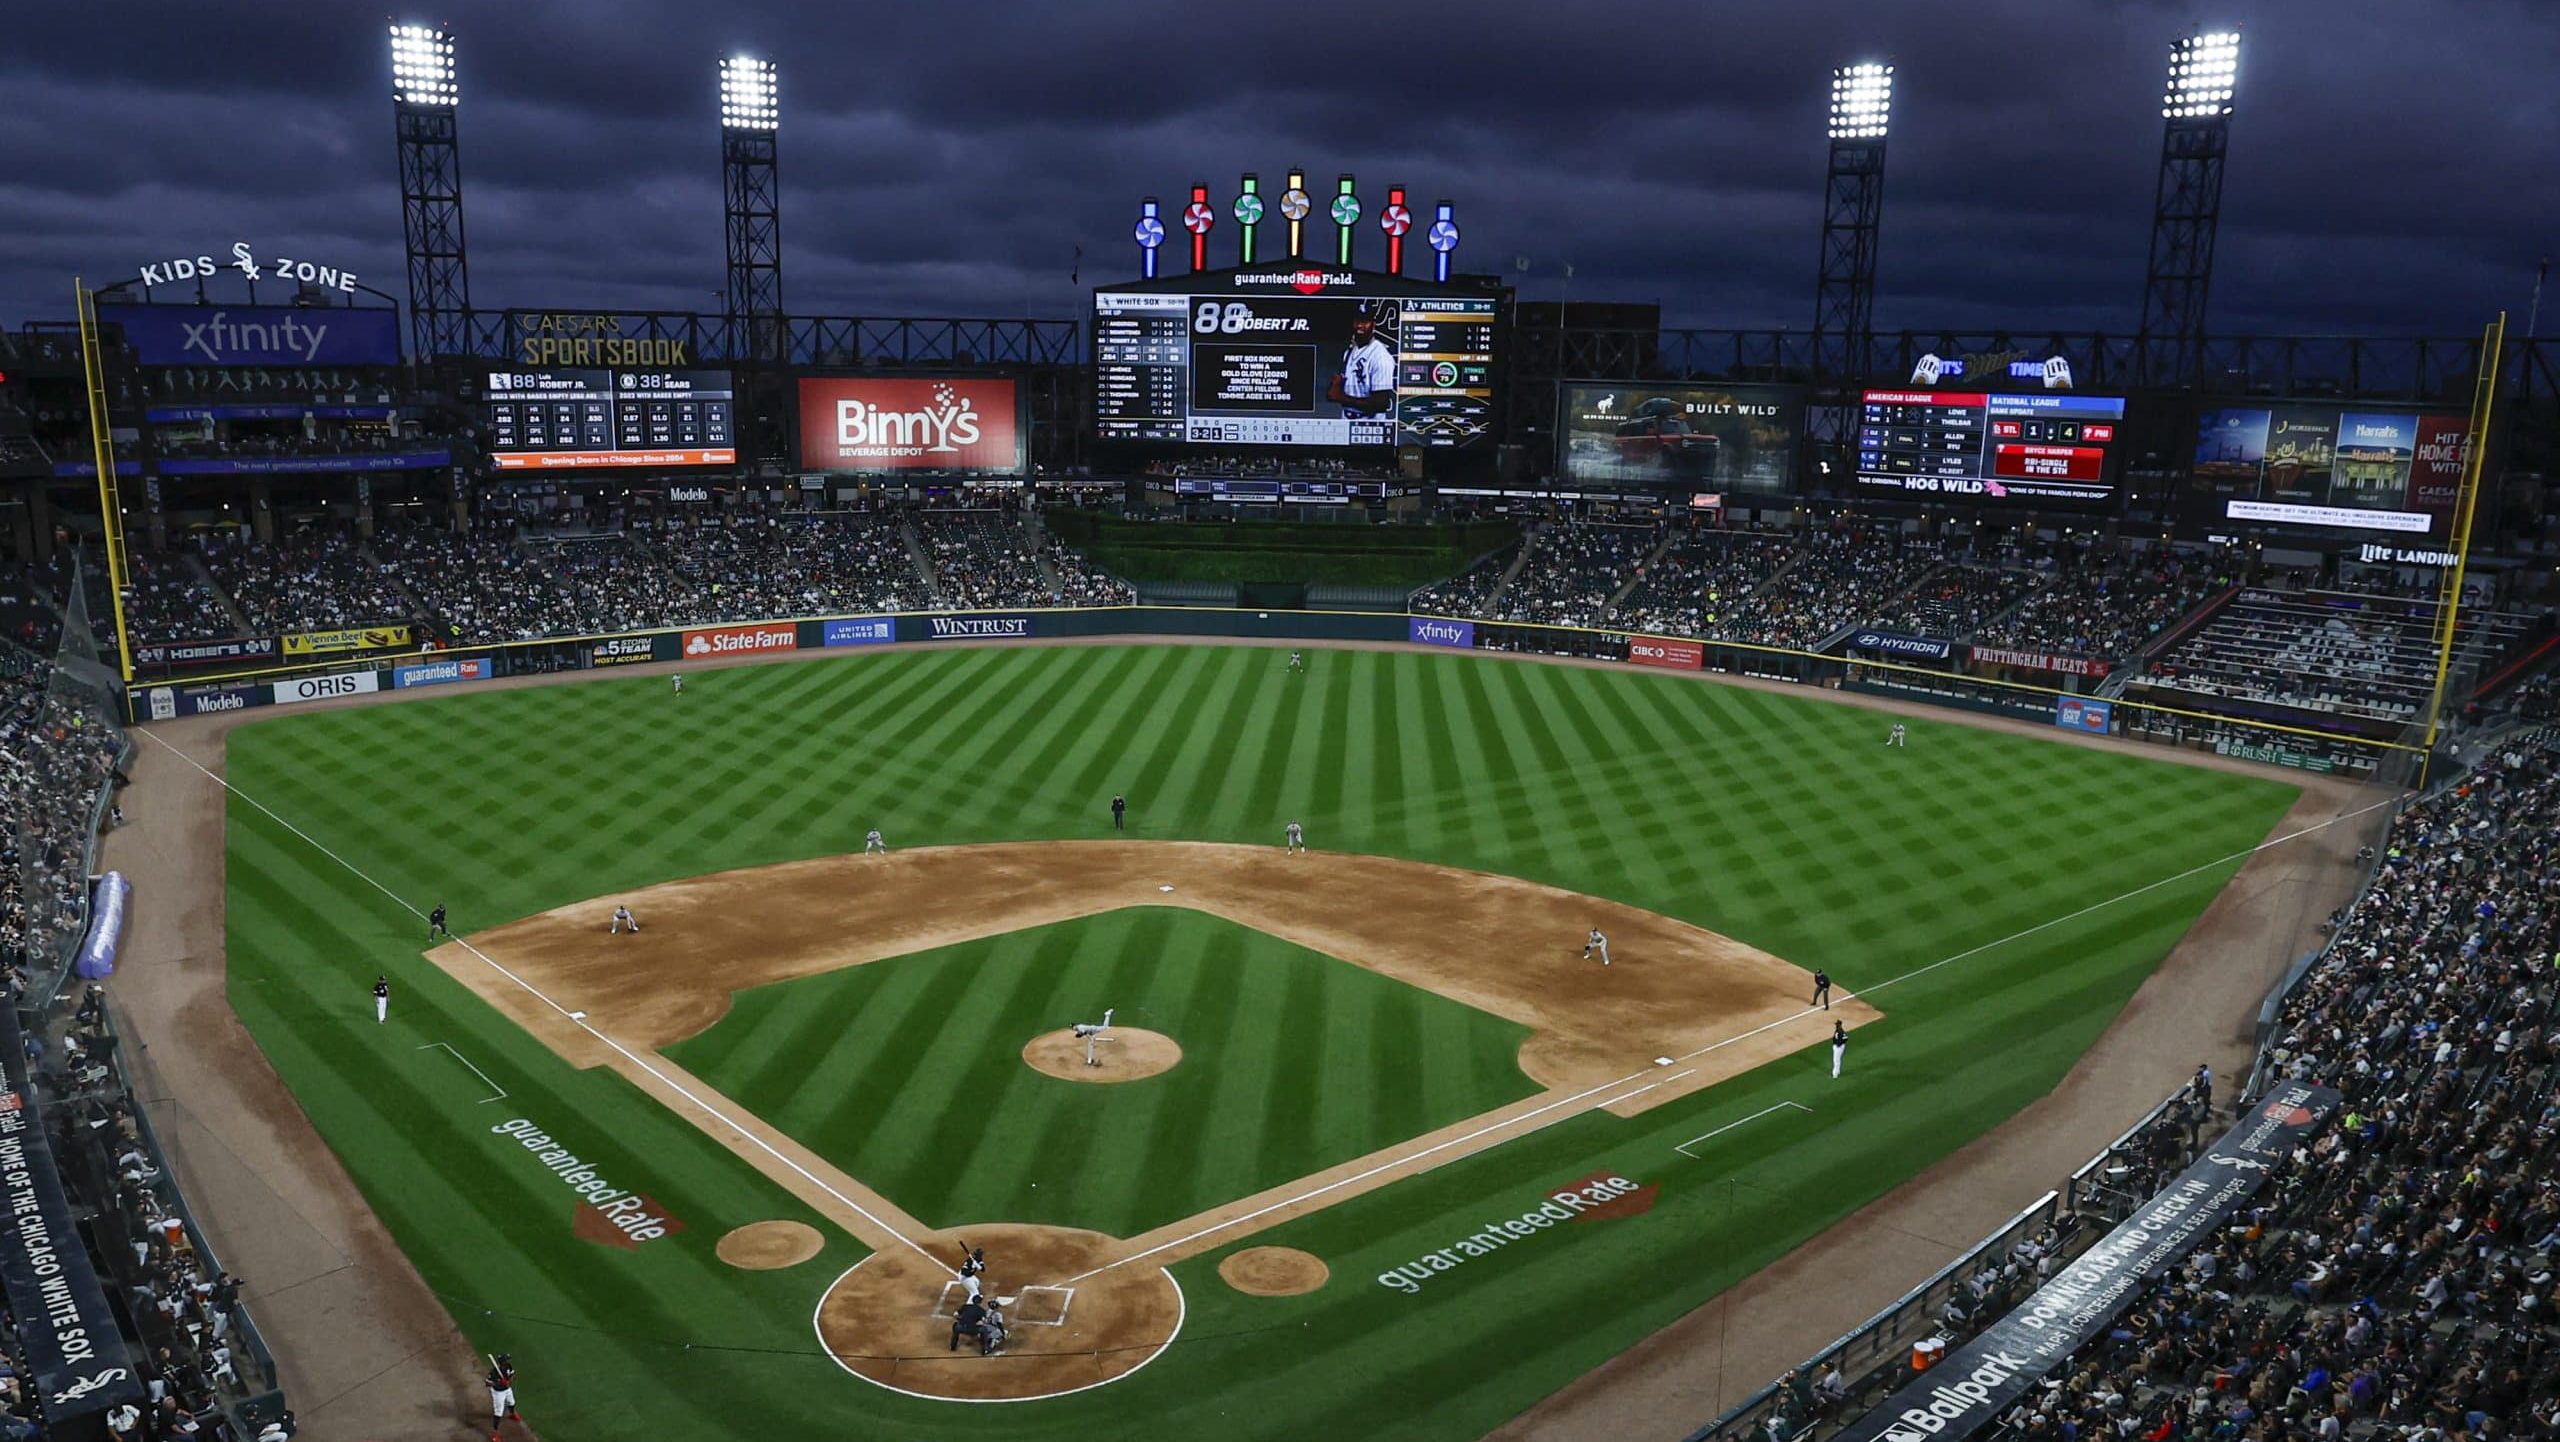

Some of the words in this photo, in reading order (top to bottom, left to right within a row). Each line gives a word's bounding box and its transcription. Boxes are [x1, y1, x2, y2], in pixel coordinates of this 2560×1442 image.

[140, 255, 217, 286] KIDS
[276, 258, 358, 293] ZONE
[1116, 298, 1141, 306] WHITE
[1421, 303, 1464, 311] ATHLETICS
[523, 314, 621, 333] CAESARS
[1195, 302, 1247, 334] 88
[1236, 319, 1290, 330] ROBERT
[1290, 319, 1310, 330] JR.
[182, 312, 328, 361] xfinity
[524, 337, 687, 366] SPORTSBOOK
[2010, 362, 2044, 377] TIME
[512, 374, 535, 389] 88
[540, 381, 572, 389] ROBERT
[640, 374, 661, 388] 38
[664, 381, 690, 389] SEARS
[1866, 393, 1903, 401] AMERICAN
[1905, 394, 1932, 402] LEAGUE
[1991, 397, 2029, 405] NATIONAL
[1686, 403, 1732, 414] BUILT
[1738, 405, 1777, 416] WILD
[836, 397, 980, 452] Binny's
[2435, 433, 2460, 444] HIT
[541, 456, 575, 465] Opening
[577, 456, 599, 464] Doors
[609, 455, 642, 463] Chicago
[839, 447, 889, 456] BEVERAGE
[891, 448, 923, 457] DEPOT
[2418, 444, 2457, 460] HOME
[2431, 462, 2464, 473] WITH
[1905, 477, 1938, 491] HOG
[1942, 479, 1982, 493] WILD
[670, 487, 707, 501] Modelo
[2360, 544, 2392, 562] Lite
[838, 625, 873, 633] UNITED
[931, 618, 1027, 634] WINTRUST
[1417, 623, 1463, 643] xfinity
[303, 634, 338, 646] Vienna
[620, 637, 652, 646] STORM
[712, 633, 754, 651] State
[755, 631, 793, 647] Farm
[830, 631, 873, 640] AIRLINES
[608, 641, 620, 655] 5
[620, 644, 652, 654] TEAM
[1632, 645, 1656, 657] CIBC
[1881, 638, 1941, 653] HYUNDAI
[594, 656, 614, 665] MOST
[616, 653, 652, 664] ACCURATE
[1973, 647, 2048, 669] WHITTINGHAM
[2051, 656, 2088, 675] MEATS
[404, 662, 457, 686] guaranteed
[460, 662, 479, 674] Rate
[298, 675, 356, 698] ORIS
[196, 693, 244, 713] Modelo
[2242, 747, 2277, 762] RUSH
[0, 1137, 26, 1171] HOME
[5, 1171, 34, 1193] OF
[491, 1118, 629, 1210] guaranteed
[606, 1195, 666, 1241] Rate
[10, 1188, 40, 1216] THE
[1378, 1201, 1576, 1293] guaranteed
[1552, 1176, 1639, 1212] Rate
[17, 1214, 60, 1276] CHICAGO
[2019, 1254, 2119, 1329] DOWNLOAD
[2112, 1228, 2150, 1257] AND
[2140, 1179, 2211, 1231] CHECK-IN
[2034, 1331, 2070, 1357] MAPS
[2136, 1223, 2189, 1275] EXPERIENCES
[39, 1271, 81, 1328] WHITE
[57, 1327, 94, 1365] SOX
[1900, 1351, 2031, 1434] Ballpark
